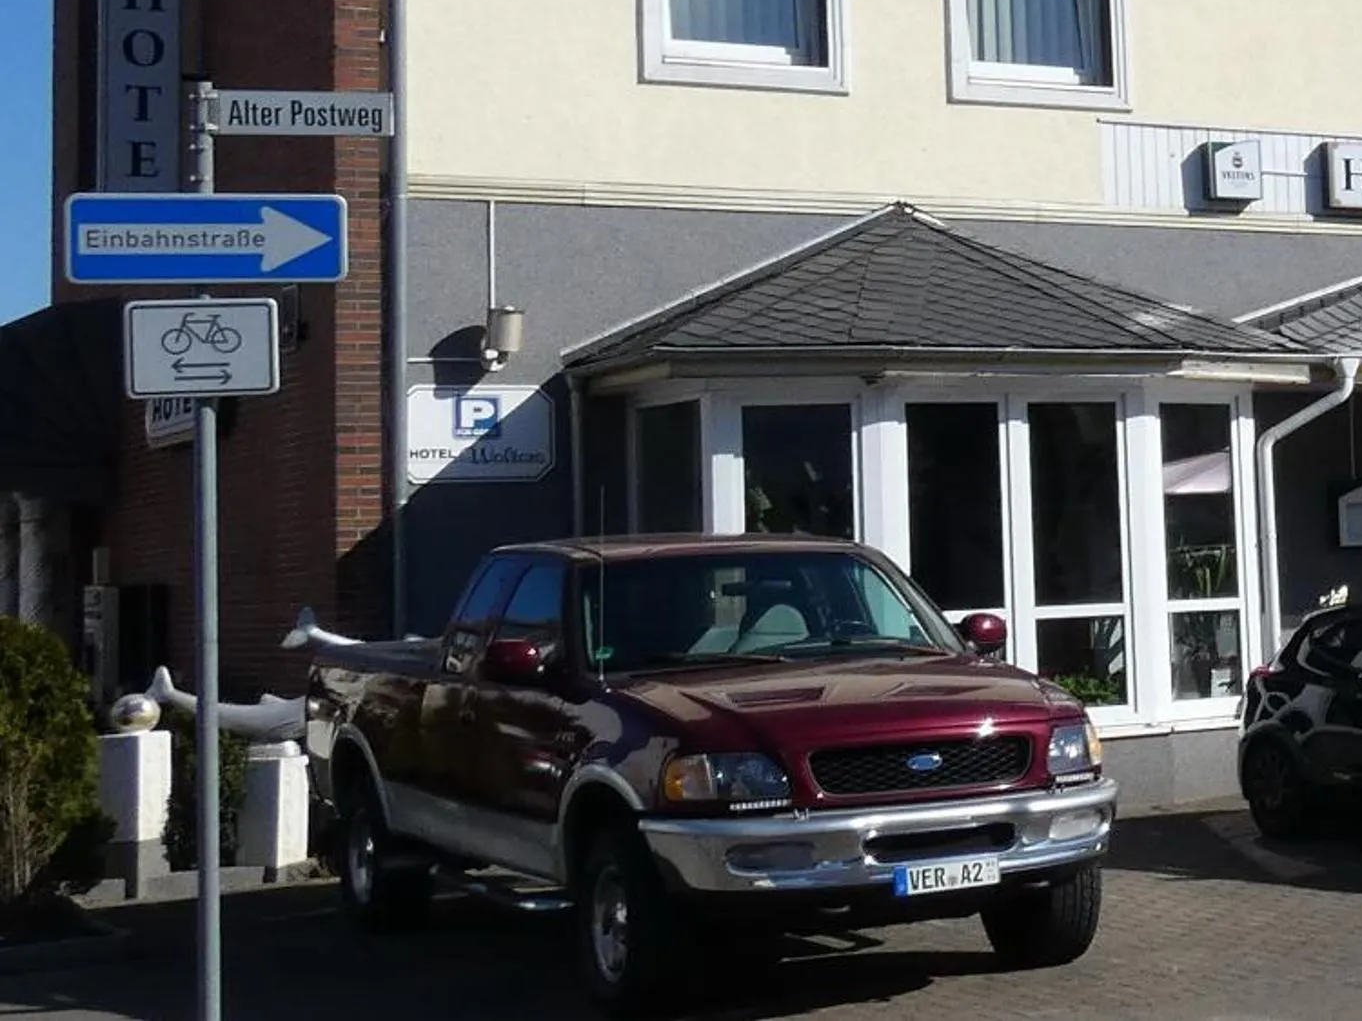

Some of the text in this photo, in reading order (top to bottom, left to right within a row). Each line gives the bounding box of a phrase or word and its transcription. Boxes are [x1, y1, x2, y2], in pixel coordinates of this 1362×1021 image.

[228, 99, 383, 133] Alter Postweg
[86, 229, 265, 248] Einbahnstraße
[409, 448, 457, 460] HOTEL
[909, 862, 984, 891] VER A2
